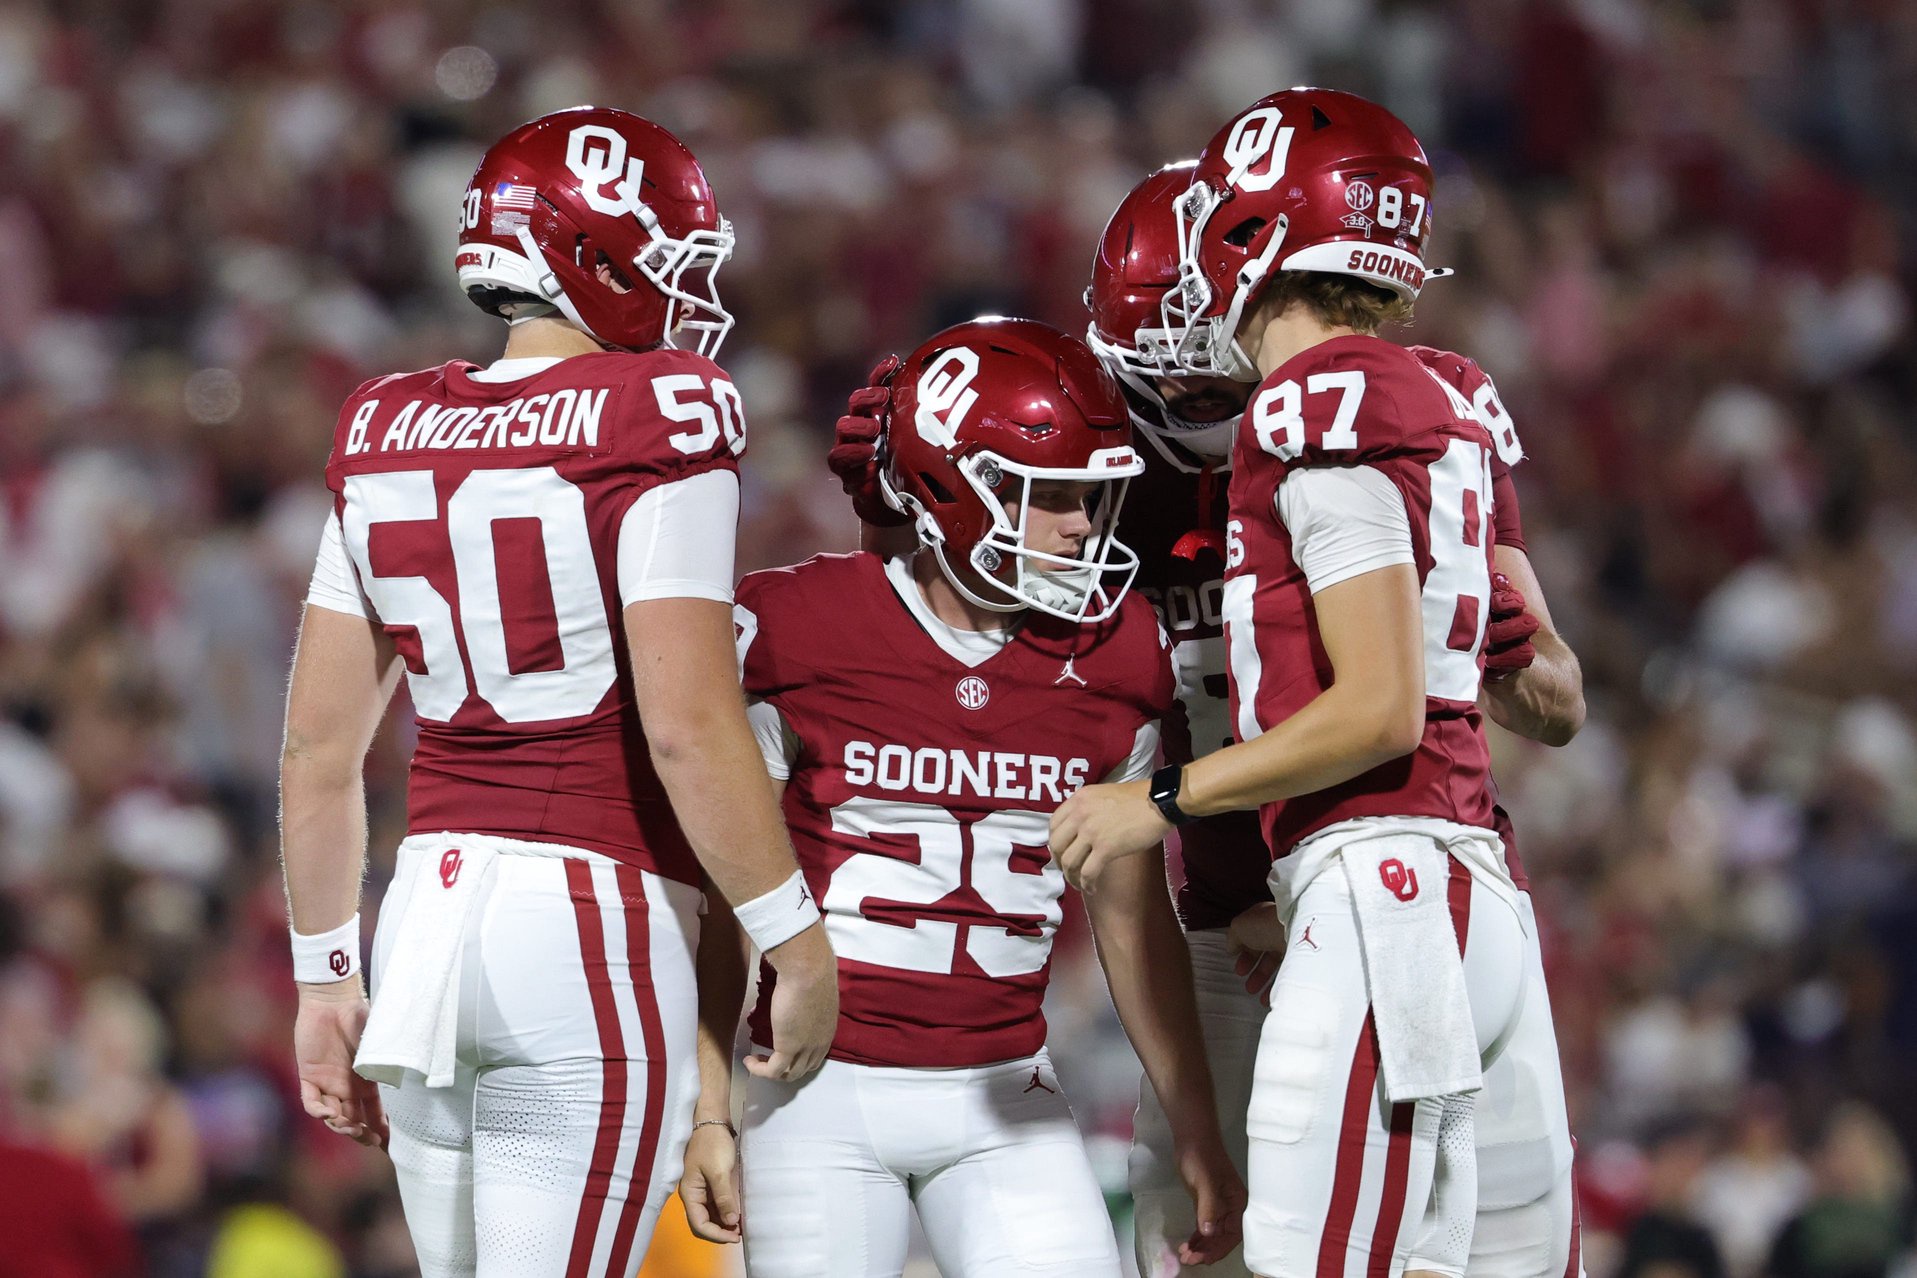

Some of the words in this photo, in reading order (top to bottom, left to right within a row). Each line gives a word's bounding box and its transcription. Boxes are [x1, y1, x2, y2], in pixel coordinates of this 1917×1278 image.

[565, 125, 645, 218] OU
[1345, 181, 1374, 211] SEC
[1377, 186, 1426, 238] 87
[1347, 250, 1426, 291] SOONER
[345, 399, 380, 456] B.
[381, 388, 610, 452] ANDERSON
[651, 374, 748, 456] 50
[1253, 370, 1367, 463] 87
[342, 466, 618, 723] 50
[957, 677, 989, 710] SEC
[844, 741, 1090, 803] SOONERS
[822, 795, 1066, 978] 29
[1379, 858, 1420, 903] OU
[329, 950, 350, 977] OU
